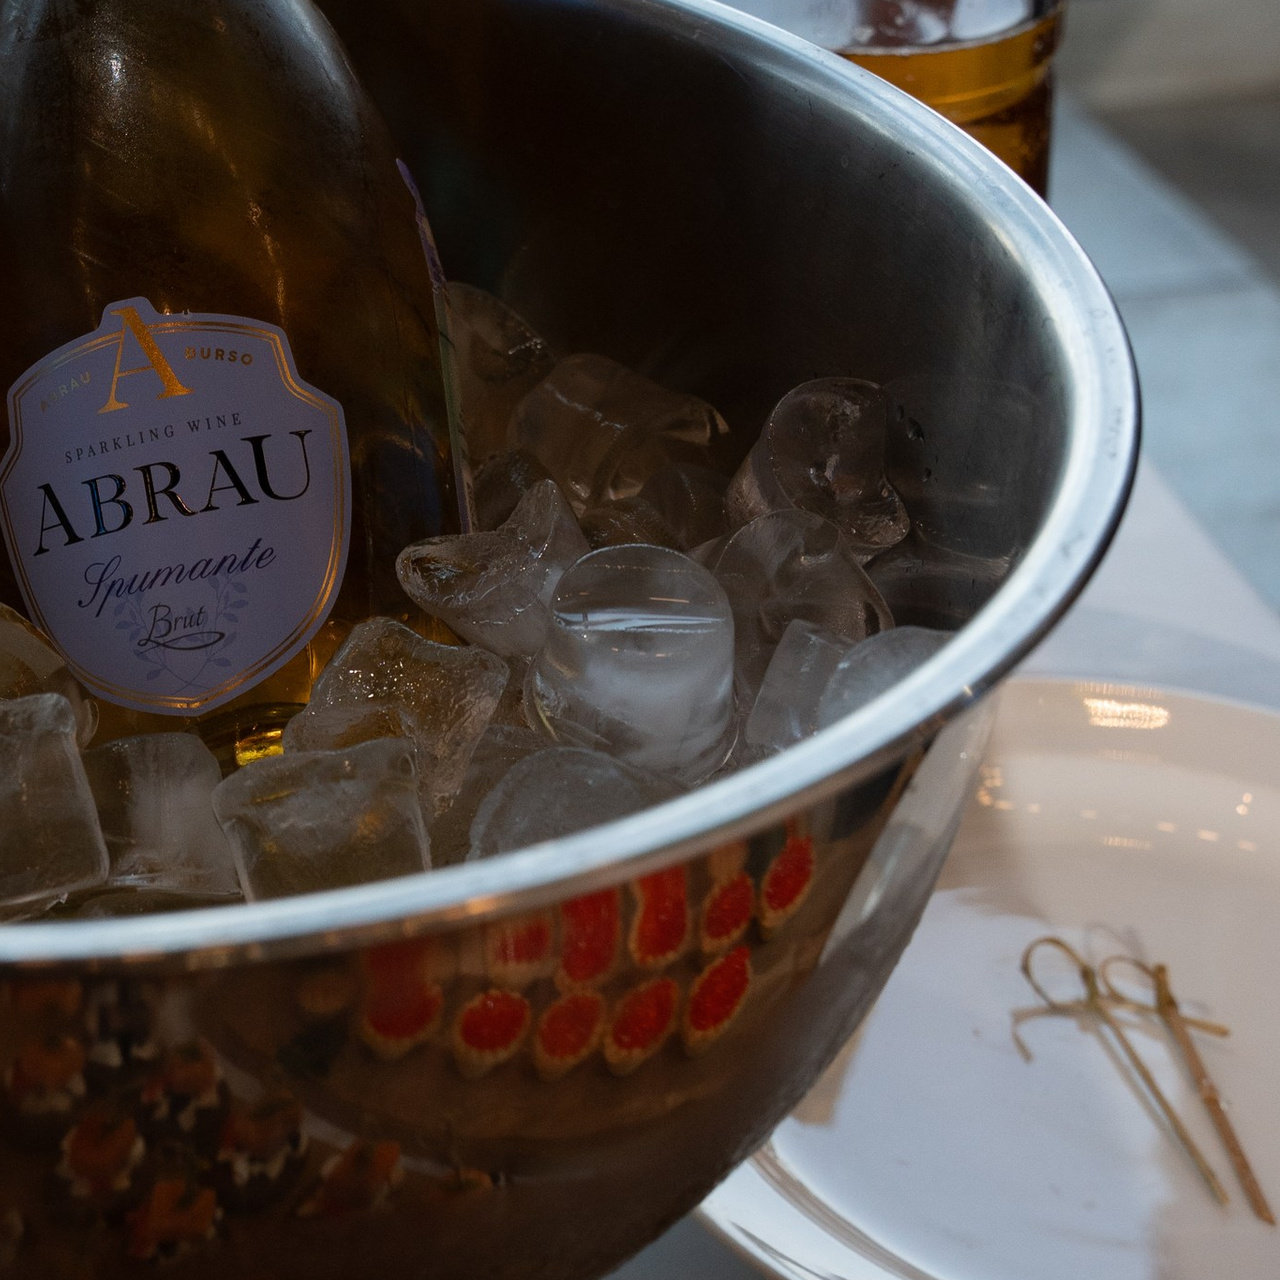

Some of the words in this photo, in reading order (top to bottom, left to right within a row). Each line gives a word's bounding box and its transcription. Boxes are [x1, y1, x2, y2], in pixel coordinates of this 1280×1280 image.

[97, 306, 195, 415] A
[185, 346, 254, 366] DURSO
[65, 424, 176, 465] SPARKLING
[187, 412, 243, 432] WINE
[32, 429, 313, 557] ABRAU
[77, 537, 278, 617] Spumante
[137, 602, 220, 649] Brut
